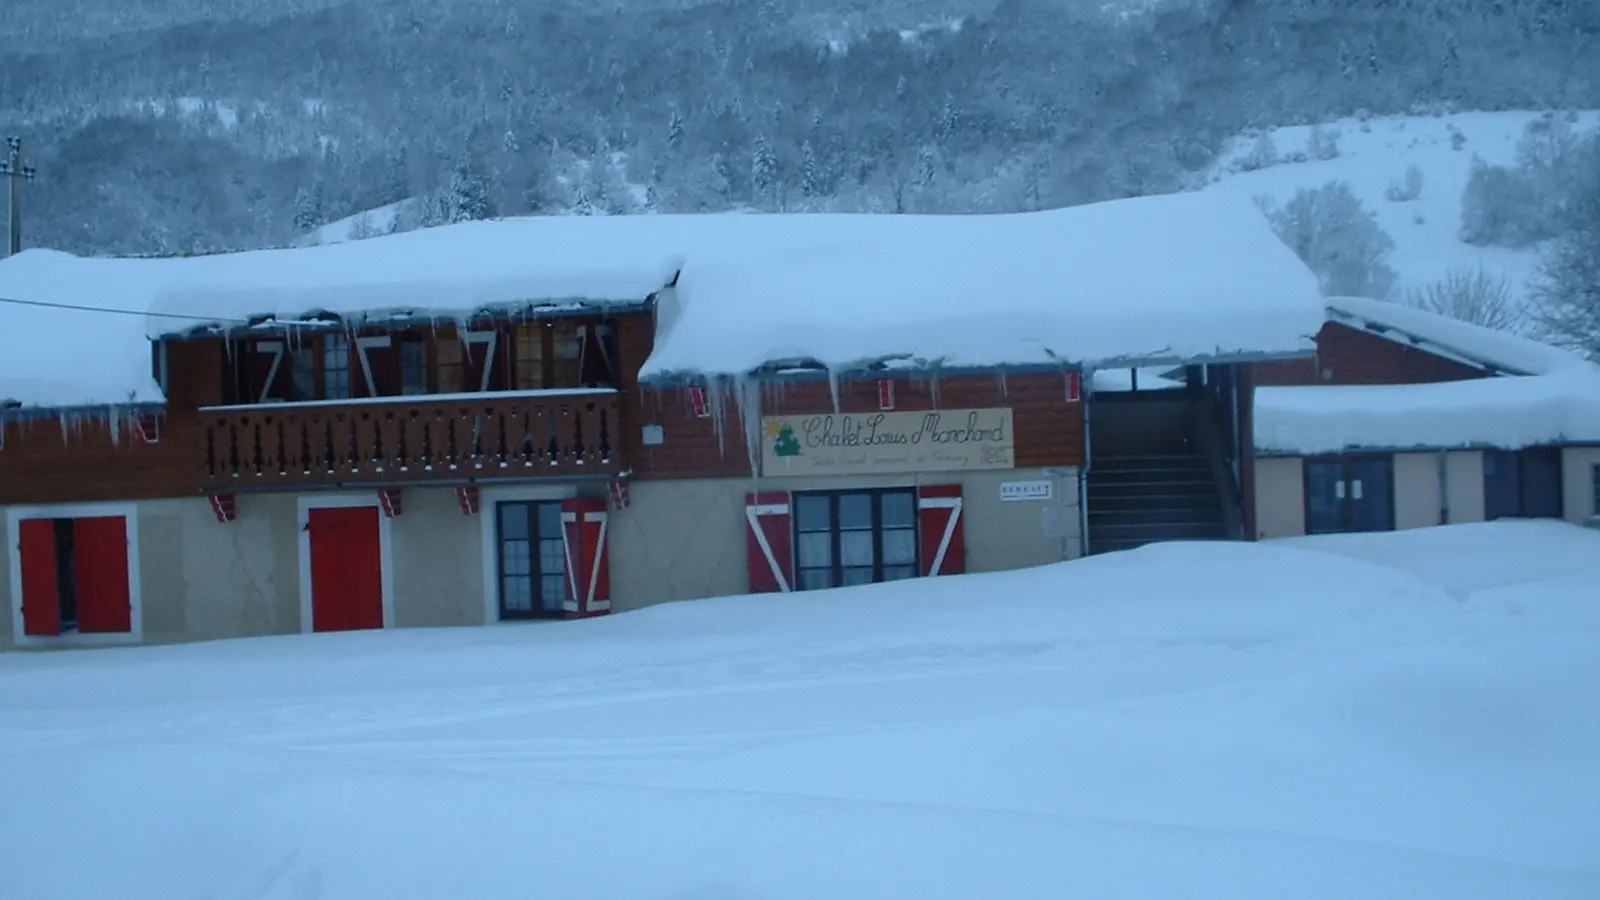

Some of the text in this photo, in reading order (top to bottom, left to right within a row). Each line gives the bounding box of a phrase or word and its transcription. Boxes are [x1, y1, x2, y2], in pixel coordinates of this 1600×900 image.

[802, 411, 1005, 448] Chalet Louis Marchand
